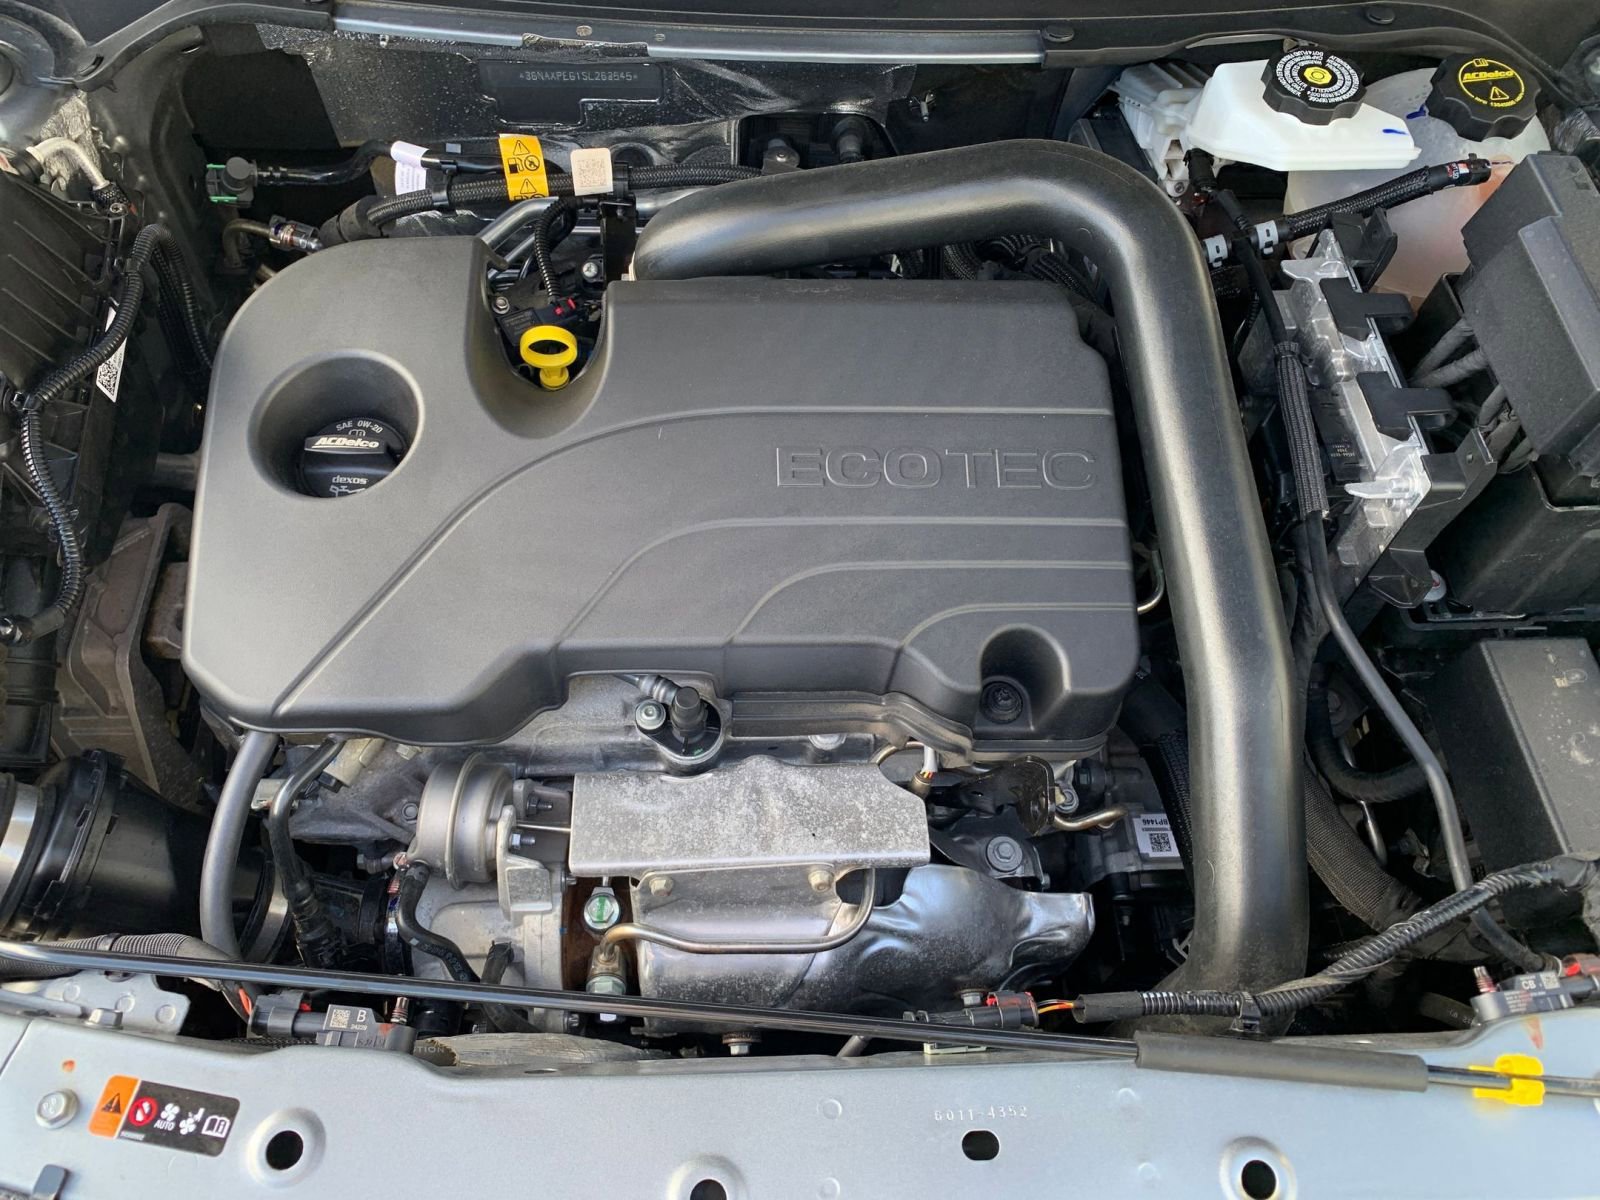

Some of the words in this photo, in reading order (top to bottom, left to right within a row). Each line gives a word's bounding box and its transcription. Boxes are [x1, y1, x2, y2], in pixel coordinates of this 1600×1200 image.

[336, 420, 353, 431] SAE
[357, 420, 383, 434] 0W-20
[313, 437, 380, 448] ACDelco
[775, 447, 1097, 490] ECOTEC
[331, 475, 368, 485] dexos
[1521, 980, 1537, 989] CB
[356, 1009, 367, 1023] B
[153, 1119, 176, 1131] AUTO
